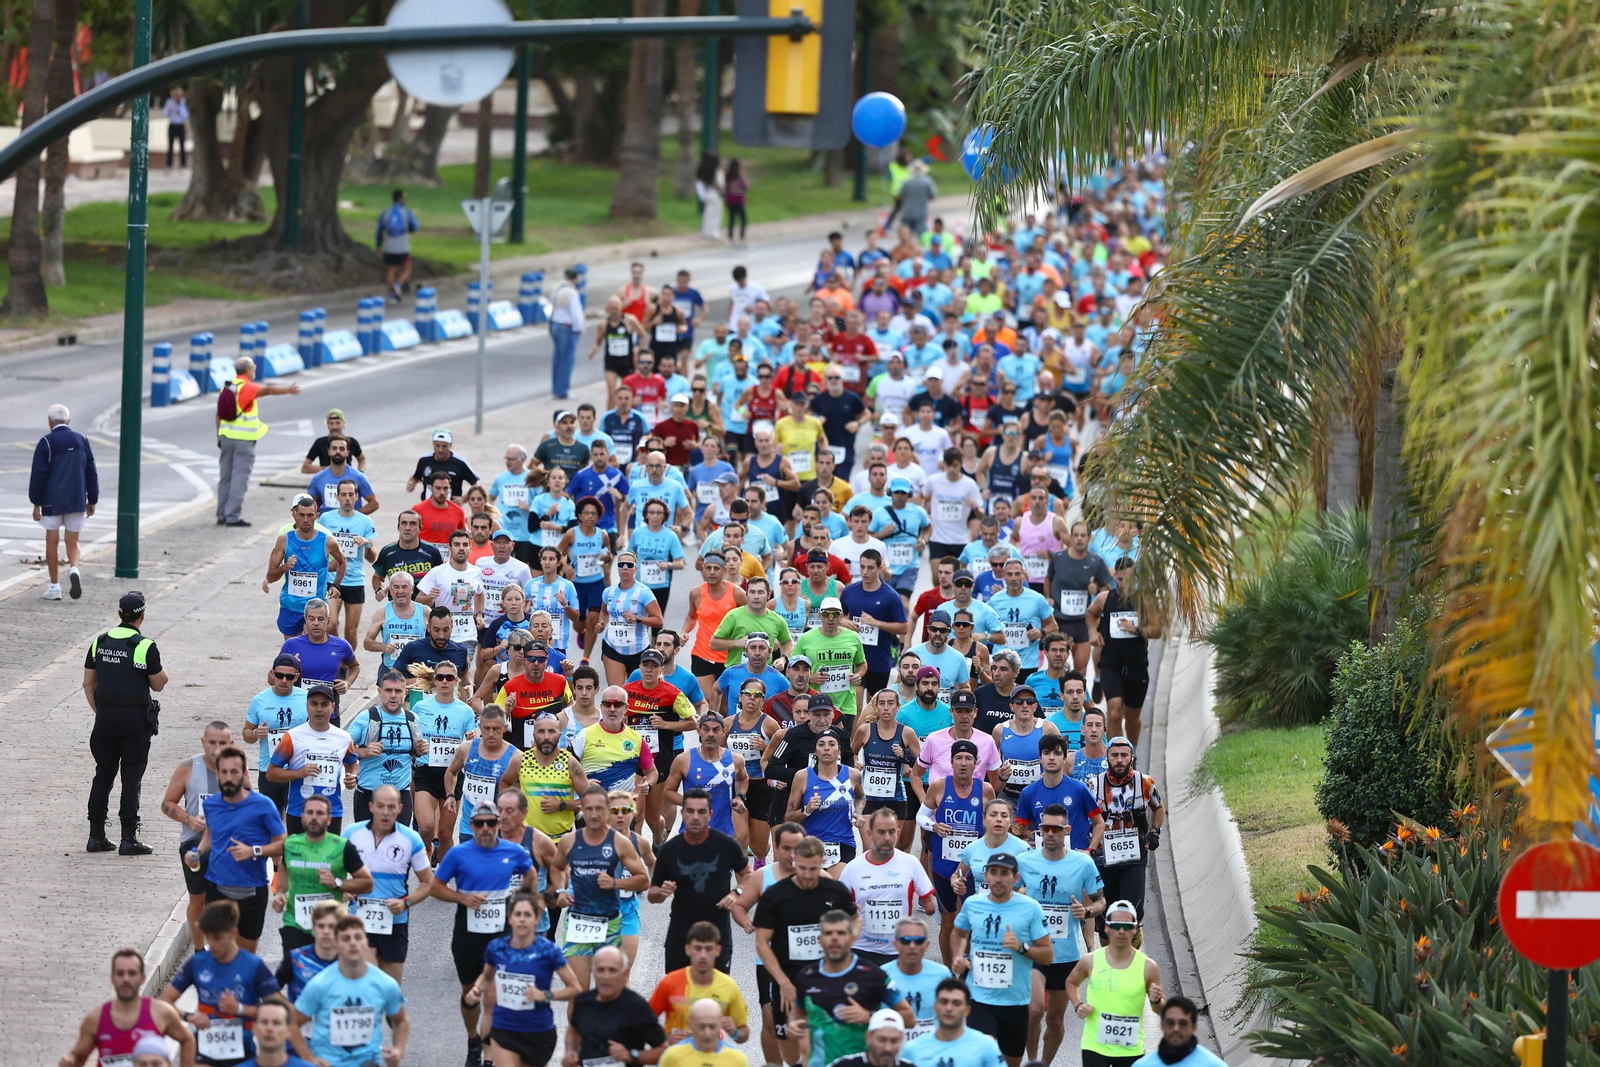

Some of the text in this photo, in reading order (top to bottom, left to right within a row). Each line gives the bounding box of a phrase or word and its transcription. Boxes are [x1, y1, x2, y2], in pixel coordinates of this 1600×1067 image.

[639, 547, 663, 555] nerja
[293, 579, 312, 588] 6961
[486, 592, 501, 600] 318
[1005, 630, 1024, 638] 9987
[97, 648, 113, 656] POLICÍA
[102, 655, 120, 663] MÁLAGA
[520, 690, 553, 699] Málaga
[628, 692, 660, 704] Málaga
[634, 700, 659, 710] Bahía
[1013, 769, 1035, 777] 6691
[870, 776, 891, 785] 6807
[467, 783, 488, 794] 6161
[944, 808, 977, 824] RCM
[1111, 841, 1134, 852] 6655
[366, 910, 384, 921] 273
[474, 909, 500, 919] 6509
[869, 910, 900, 920] 11130
[575, 923, 601, 933] 6779
[980, 962, 1006, 973] 1152
[336, 1018, 372, 1029] 11790
[1105, 1025, 1132, 1036] 9621
[206, 1031, 236, 1042] 9564
